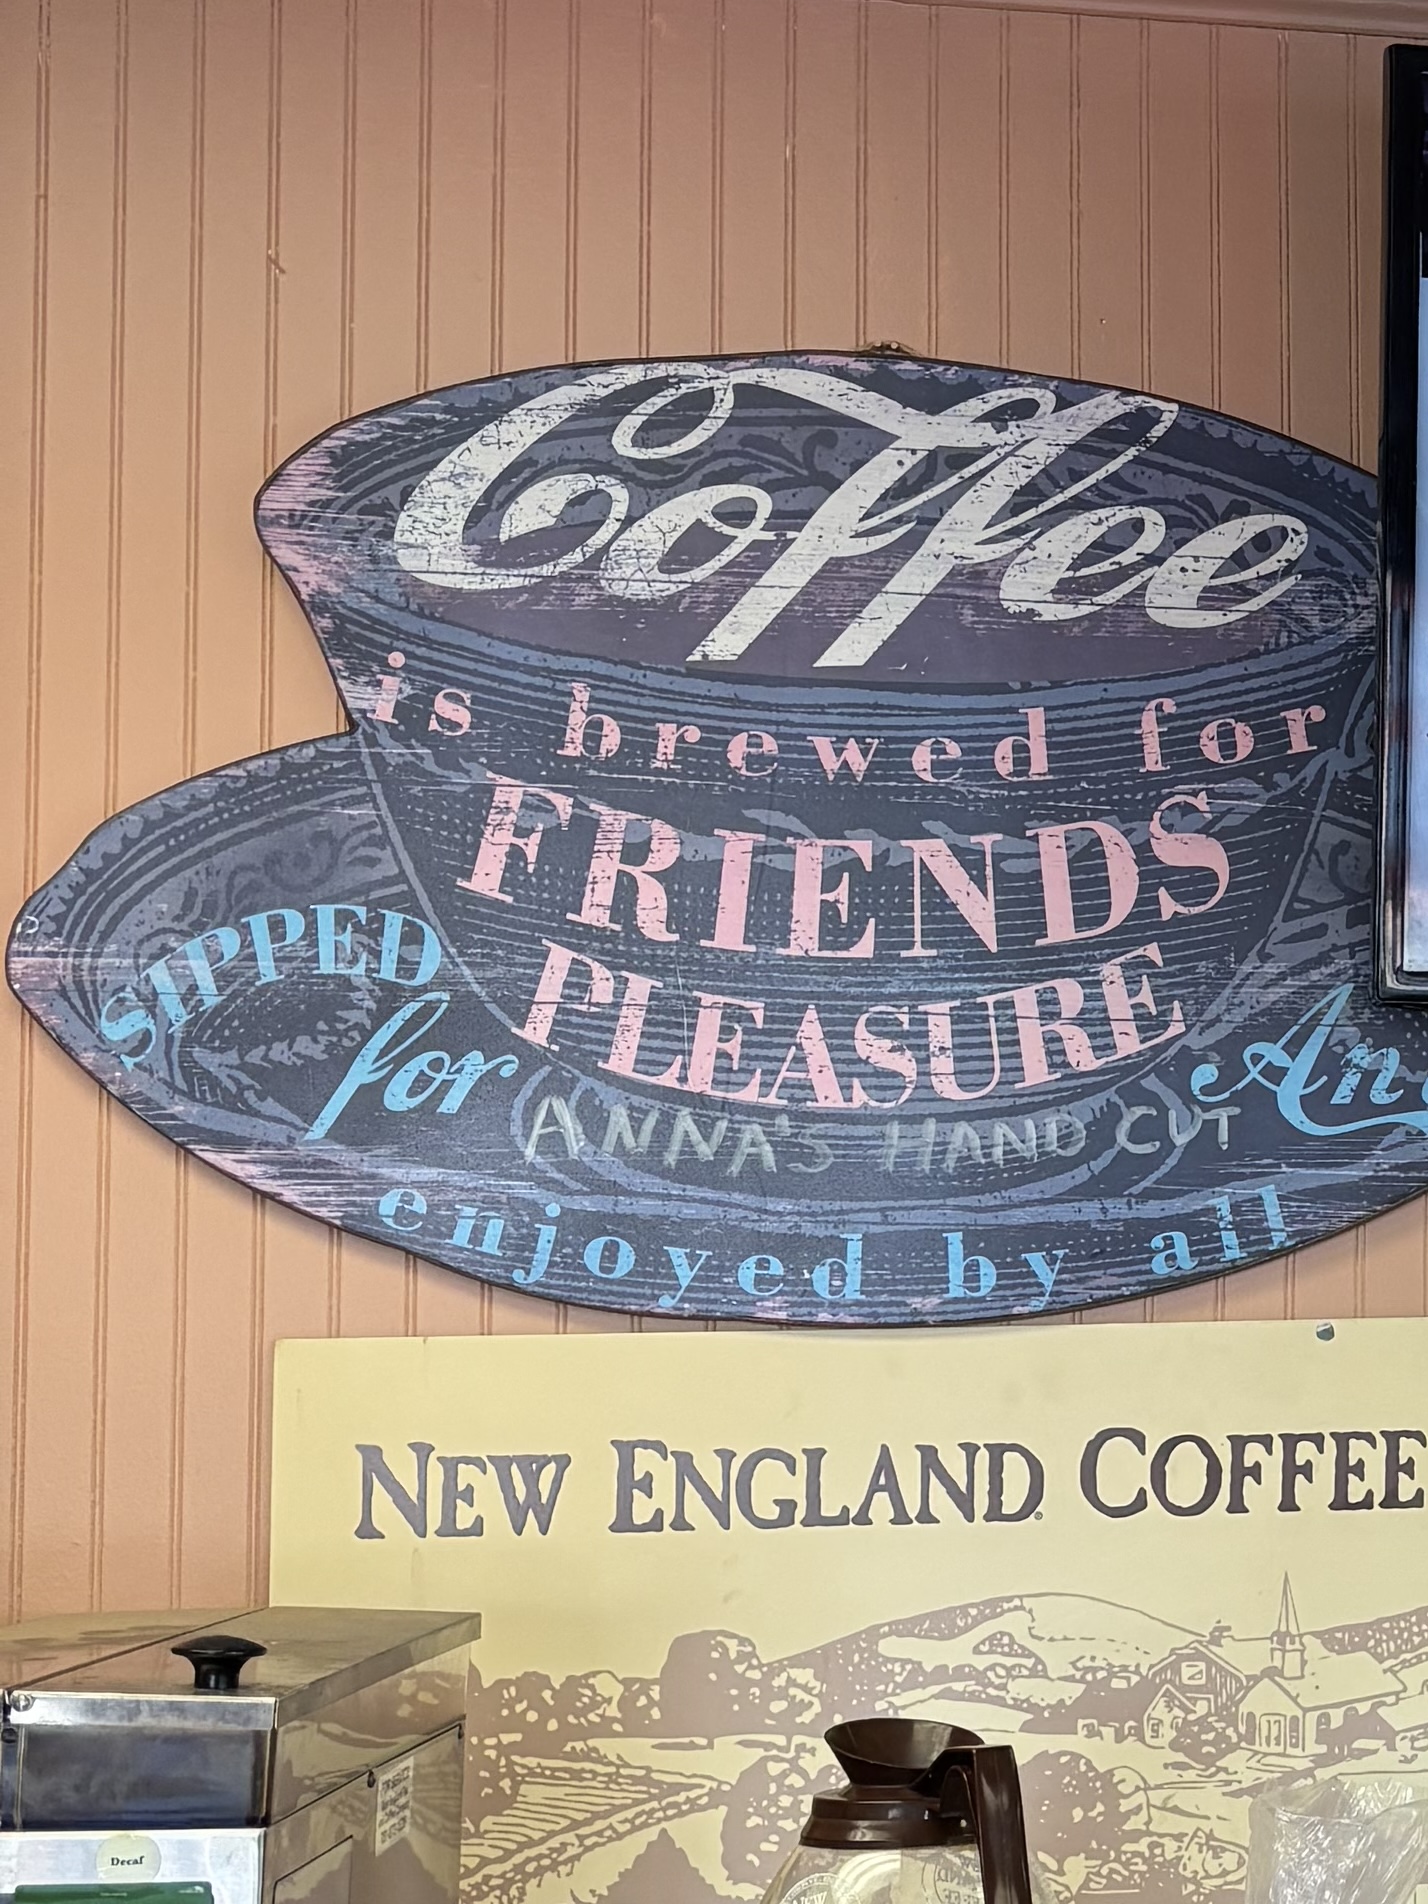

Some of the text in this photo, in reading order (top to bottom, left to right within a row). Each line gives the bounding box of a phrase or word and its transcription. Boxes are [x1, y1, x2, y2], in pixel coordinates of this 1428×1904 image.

[396, 360, 1309, 668] Coffee
[367, 651, 1326, 784] is brewed for
[457, 770, 1231, 958] FRIENDS
[97, 903, 443, 1070] SIPPED
[511, 938, 1187, 1109] PLEASURE
[304, 992, 519, 1142] for
[525, 1096, 1241, 1175] ANNA'S HAND CUT
[377, 1185, 1288, 1312] enjoyed by all
[354, 1427, 1427, 1541] NEW ENGLAND COFFEE
[111, 1856, 144, 1866] Decaf
